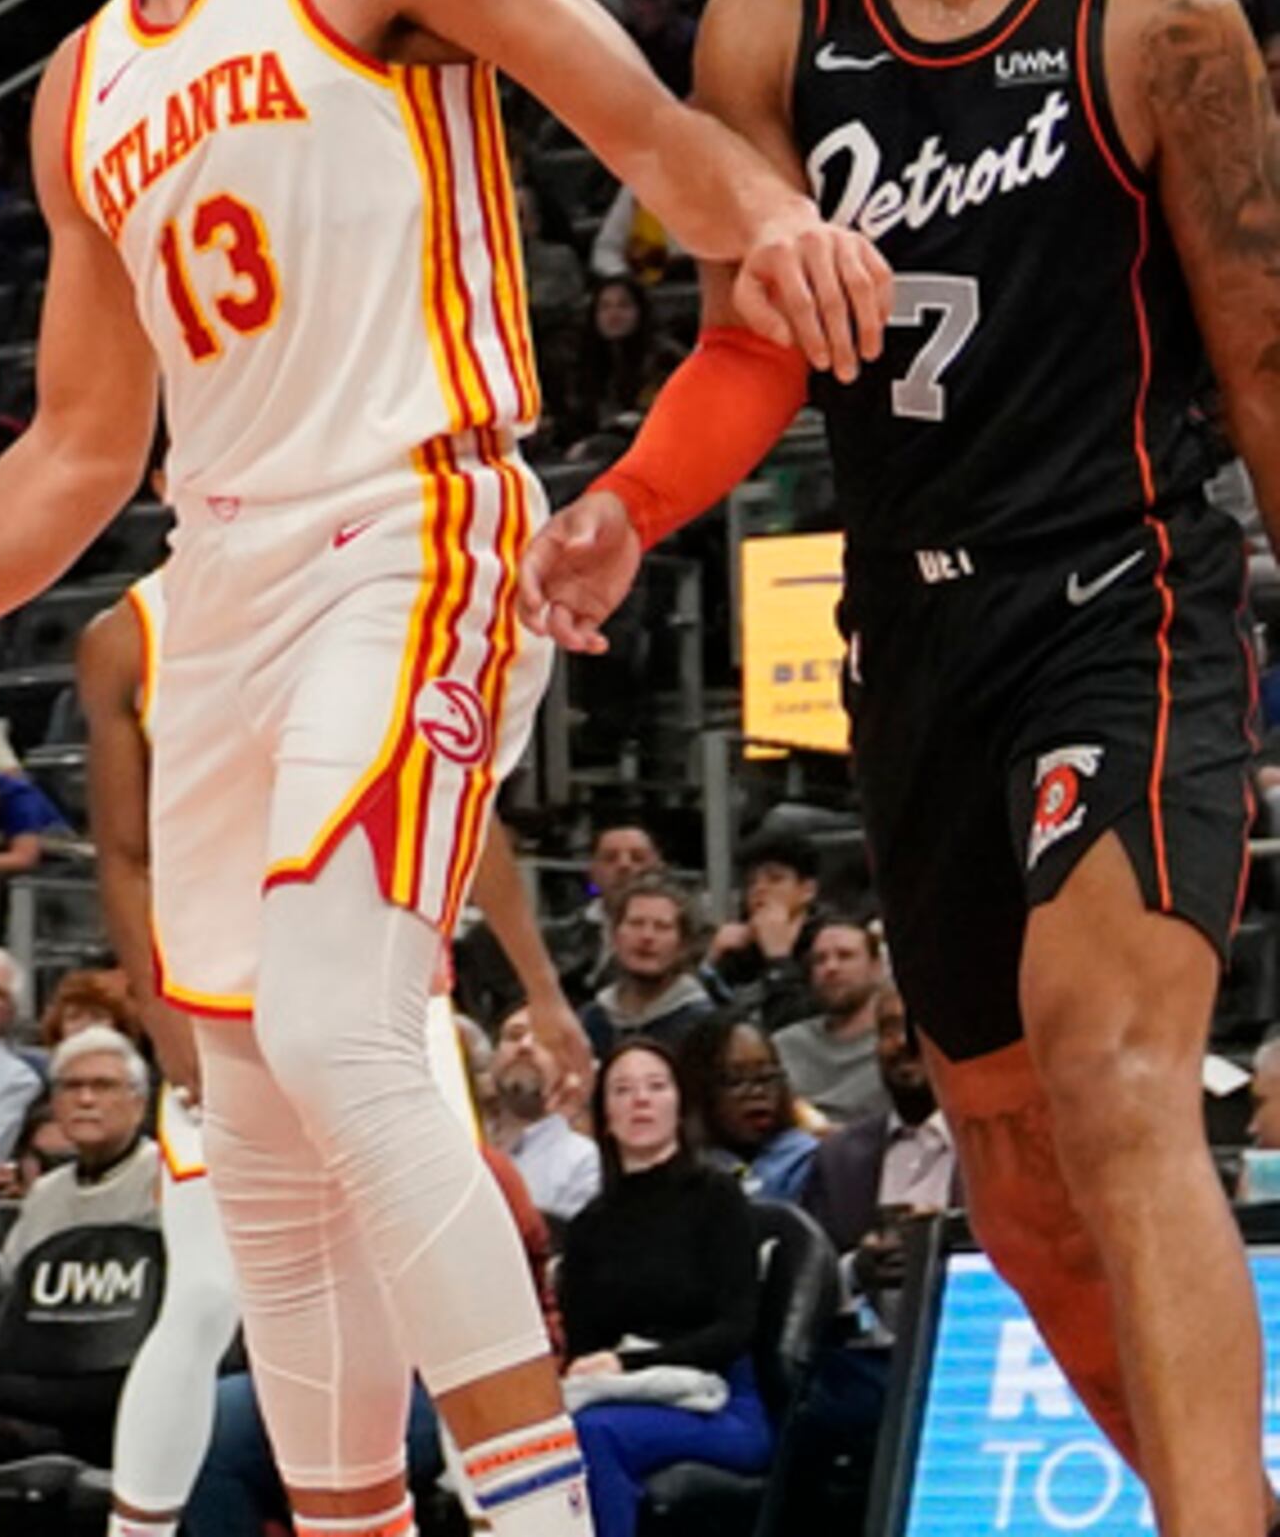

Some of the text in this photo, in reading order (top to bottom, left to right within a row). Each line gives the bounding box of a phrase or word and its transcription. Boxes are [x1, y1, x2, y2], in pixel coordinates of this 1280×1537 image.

[994, 47, 1069, 79] UWM
[91, 50, 309, 248] ATLANTA
[806, 90, 1070, 241] Detroit
[158, 192, 284, 364] 13
[887, 272, 981, 421] 7
[32, 1256, 153, 1307] UWM
[981, 1440, 1121, 1531] TO
